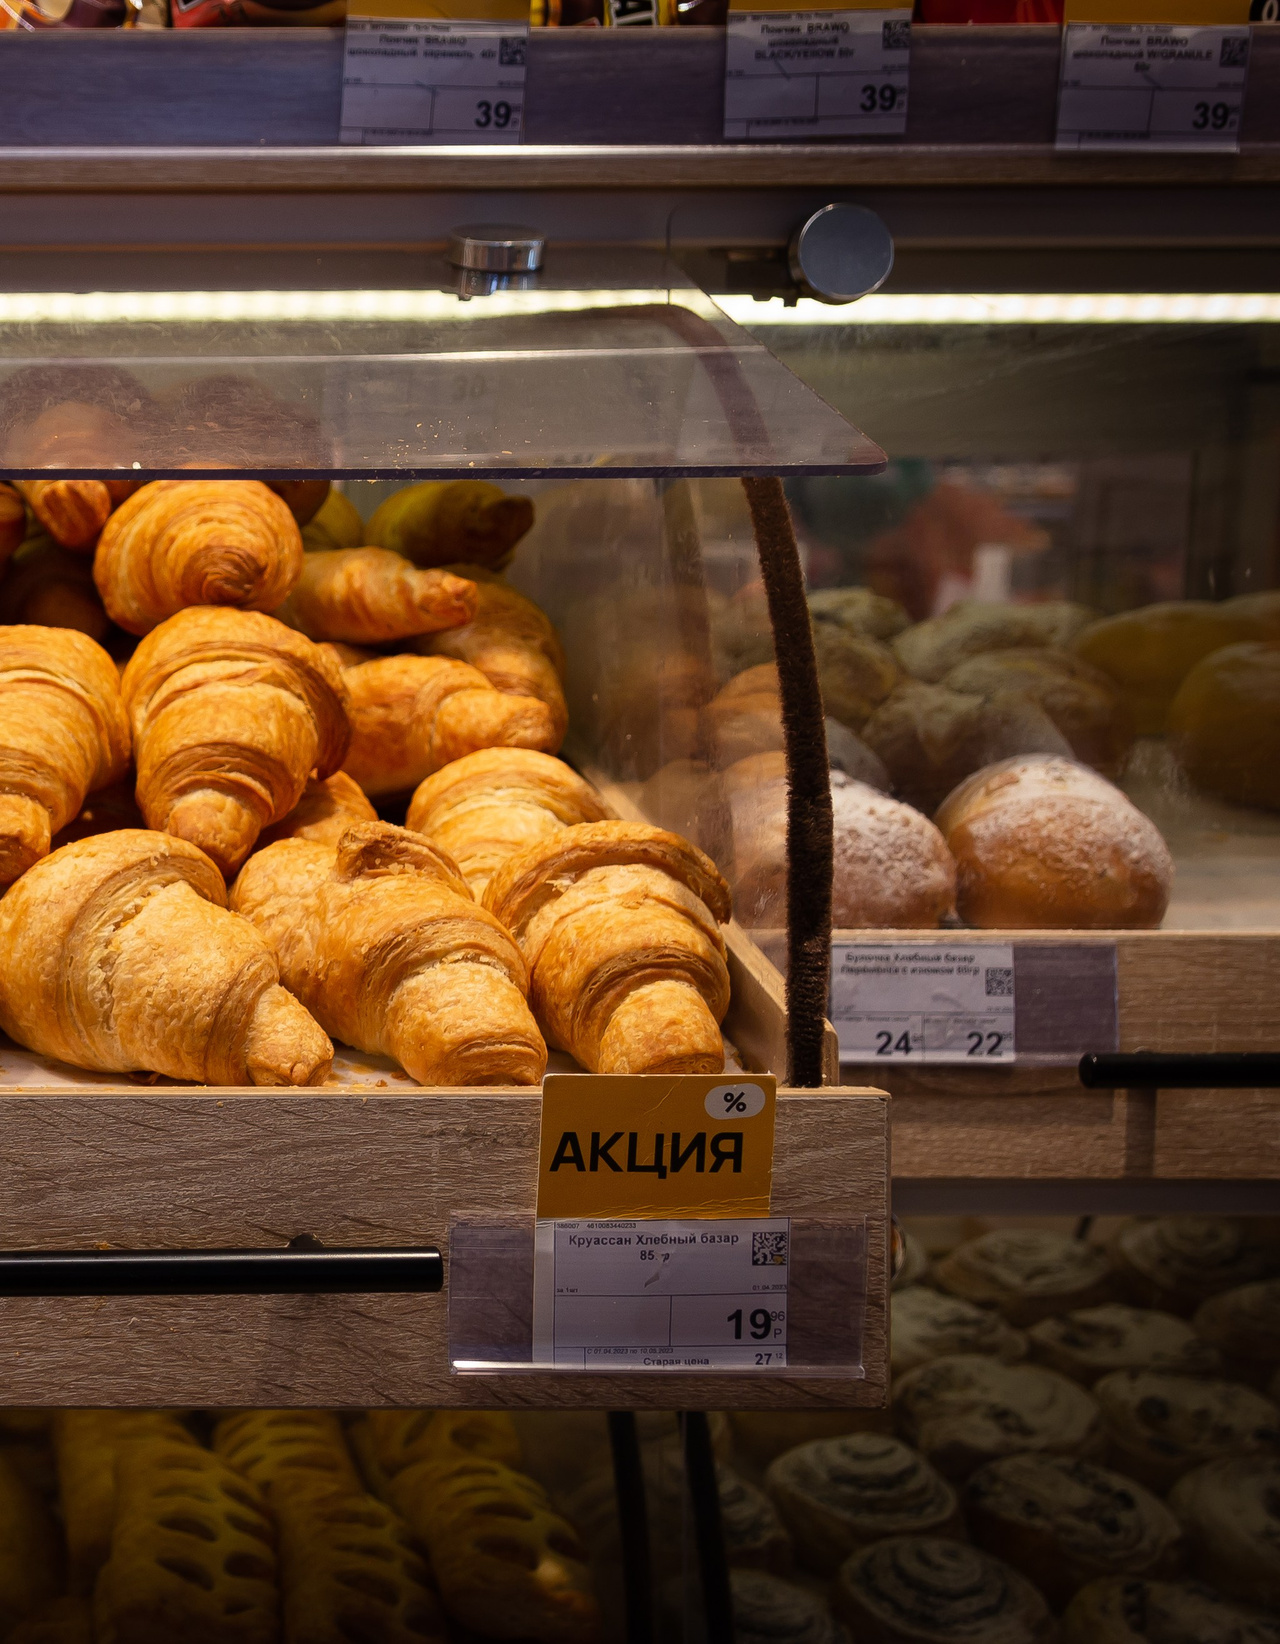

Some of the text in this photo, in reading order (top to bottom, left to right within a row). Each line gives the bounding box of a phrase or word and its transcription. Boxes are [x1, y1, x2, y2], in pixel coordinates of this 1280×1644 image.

[860, 84, 897, 112] 39
[475, 100, 512, 128] 39
[1192, 102, 1229, 130] 39
[876, 1031, 913, 1056] 24
[967, 1031, 1003, 1056] 22
[723, 1091, 747, 1113] %
[549, 1131, 744, 1180] АКЦИЯ
[568, 1232, 739, 1248] Круассан Хлебный базар
[727, 1308, 785, 1340] 19 96
[643, 1357, 681, 1367] Старая
[684, 1358, 710, 1366] цена
[755, 1353, 773, 1366] 27
